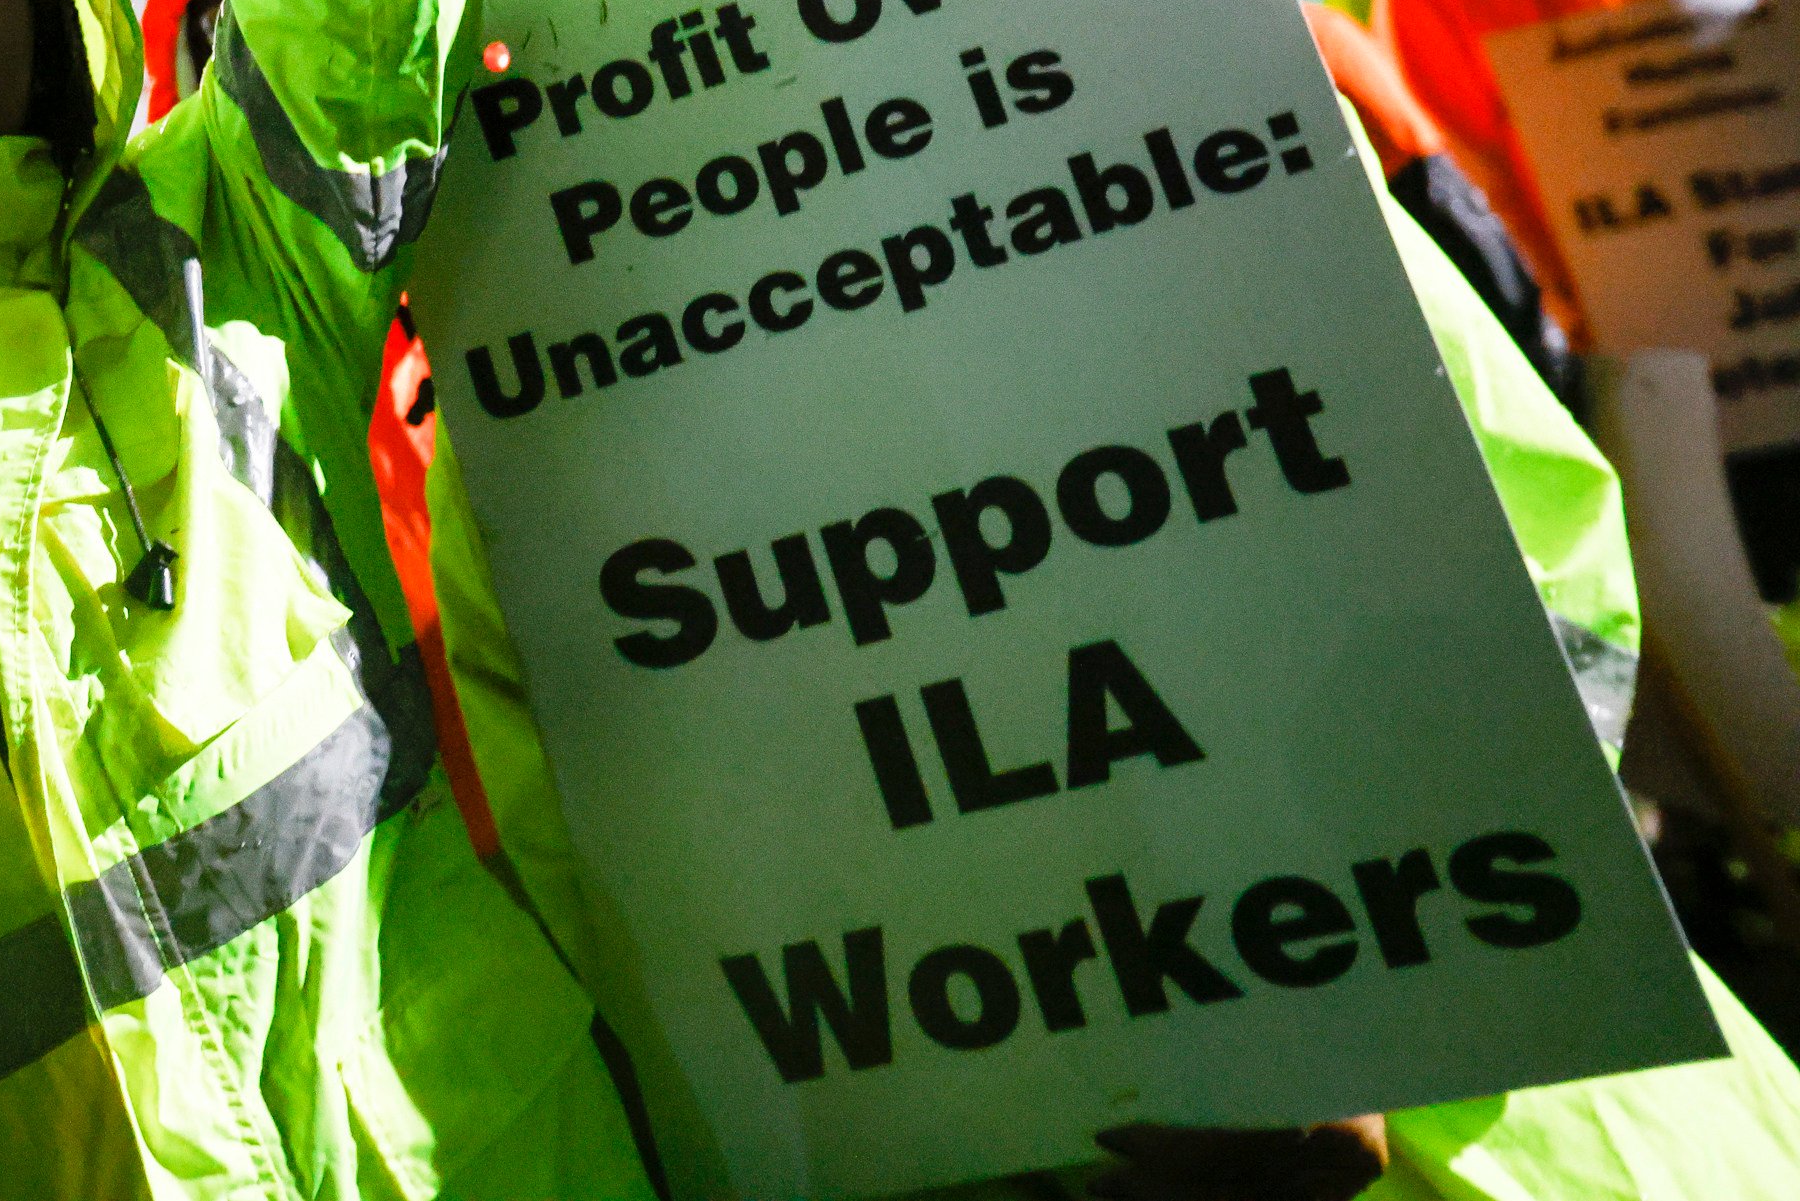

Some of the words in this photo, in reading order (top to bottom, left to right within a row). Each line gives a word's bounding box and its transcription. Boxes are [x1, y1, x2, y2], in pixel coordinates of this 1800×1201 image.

[471, 2, 771, 161] Profit
[548, 96, 933, 266] People
[959, 46, 1076, 130] is
[462, 109, 1316, 424] Unacceptable:
[597, 366, 1352, 671] Support
[853, 638, 1207, 831] ILA
[719, 829, 1584, 1085] Workers
